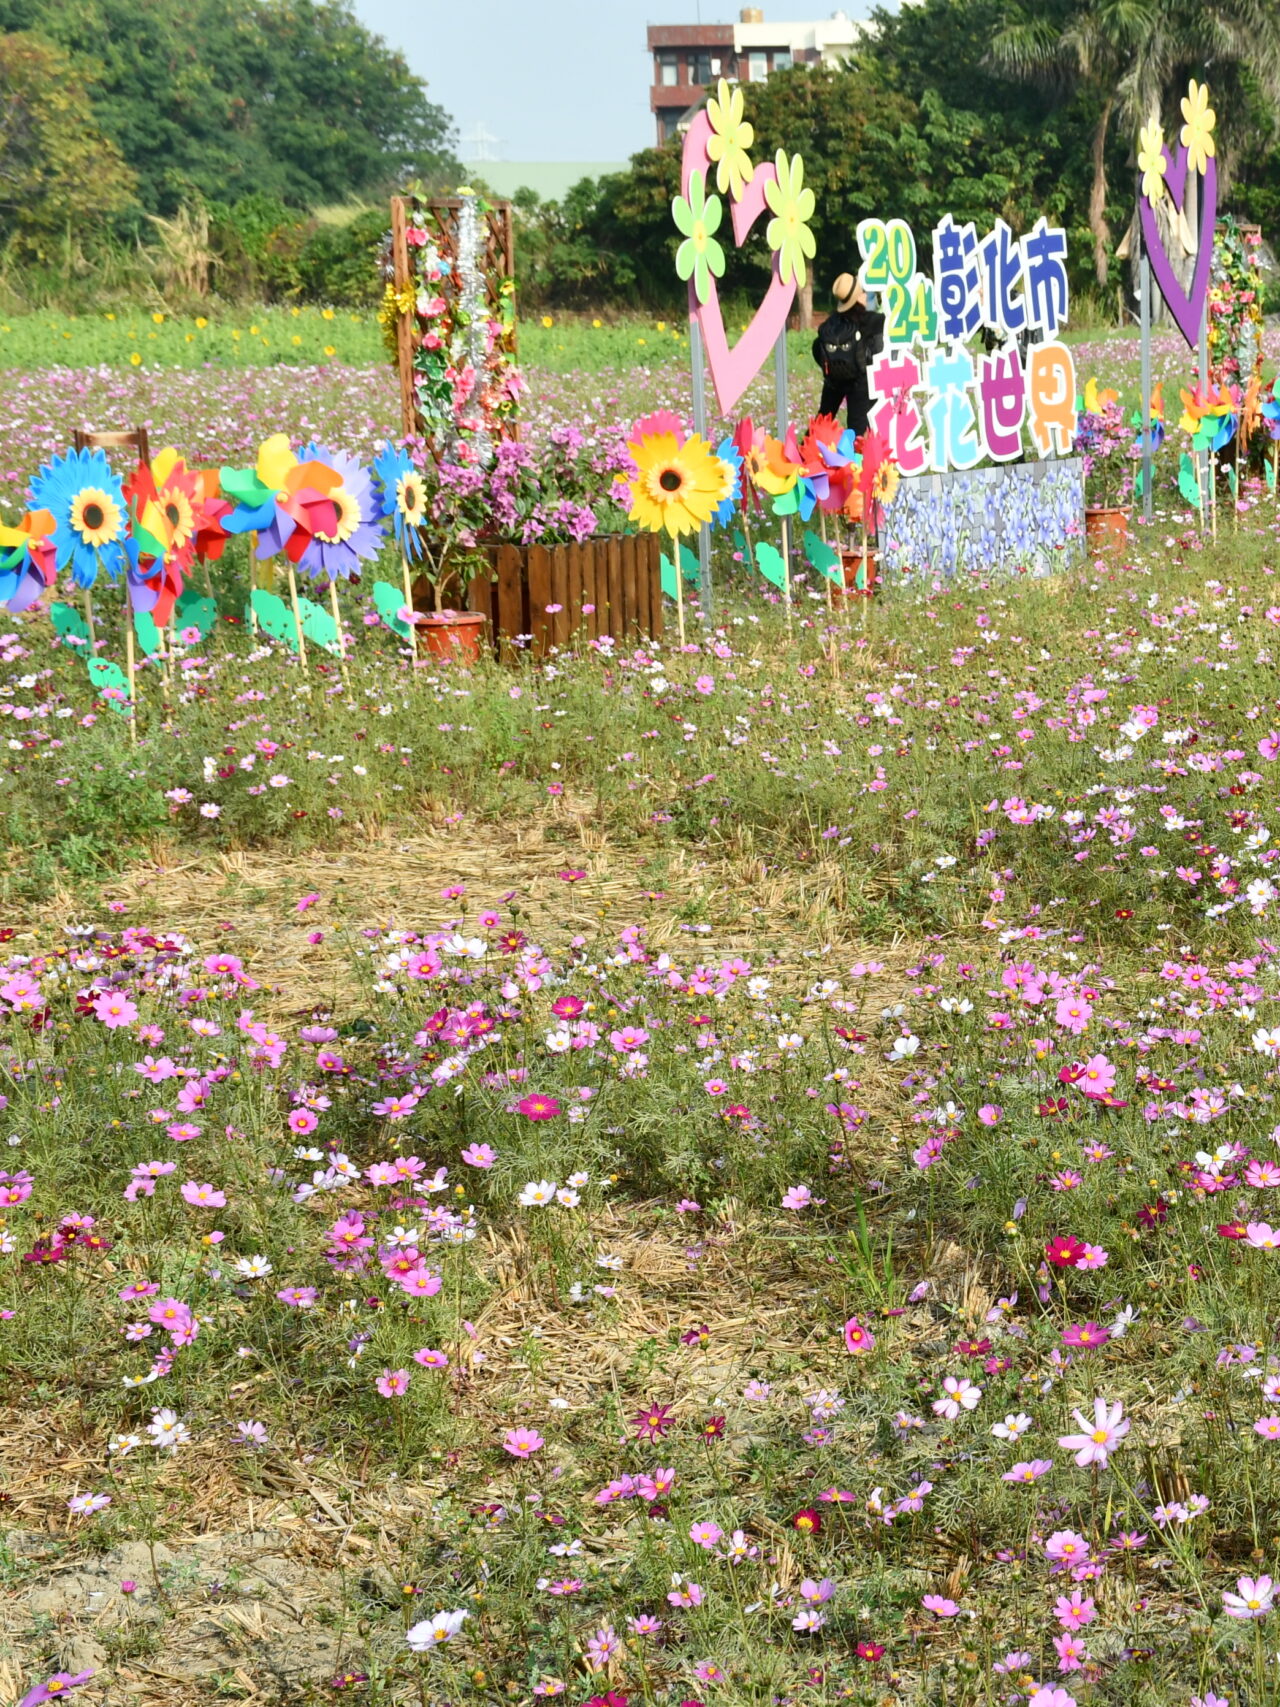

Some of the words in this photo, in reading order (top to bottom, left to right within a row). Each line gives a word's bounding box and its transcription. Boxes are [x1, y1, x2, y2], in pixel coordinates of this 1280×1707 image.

[864, 223, 914, 285] 20
[939, 223, 1065, 339] 彰化市
[885, 281, 939, 343] 24
[873, 346, 1076, 471] 花花世界
